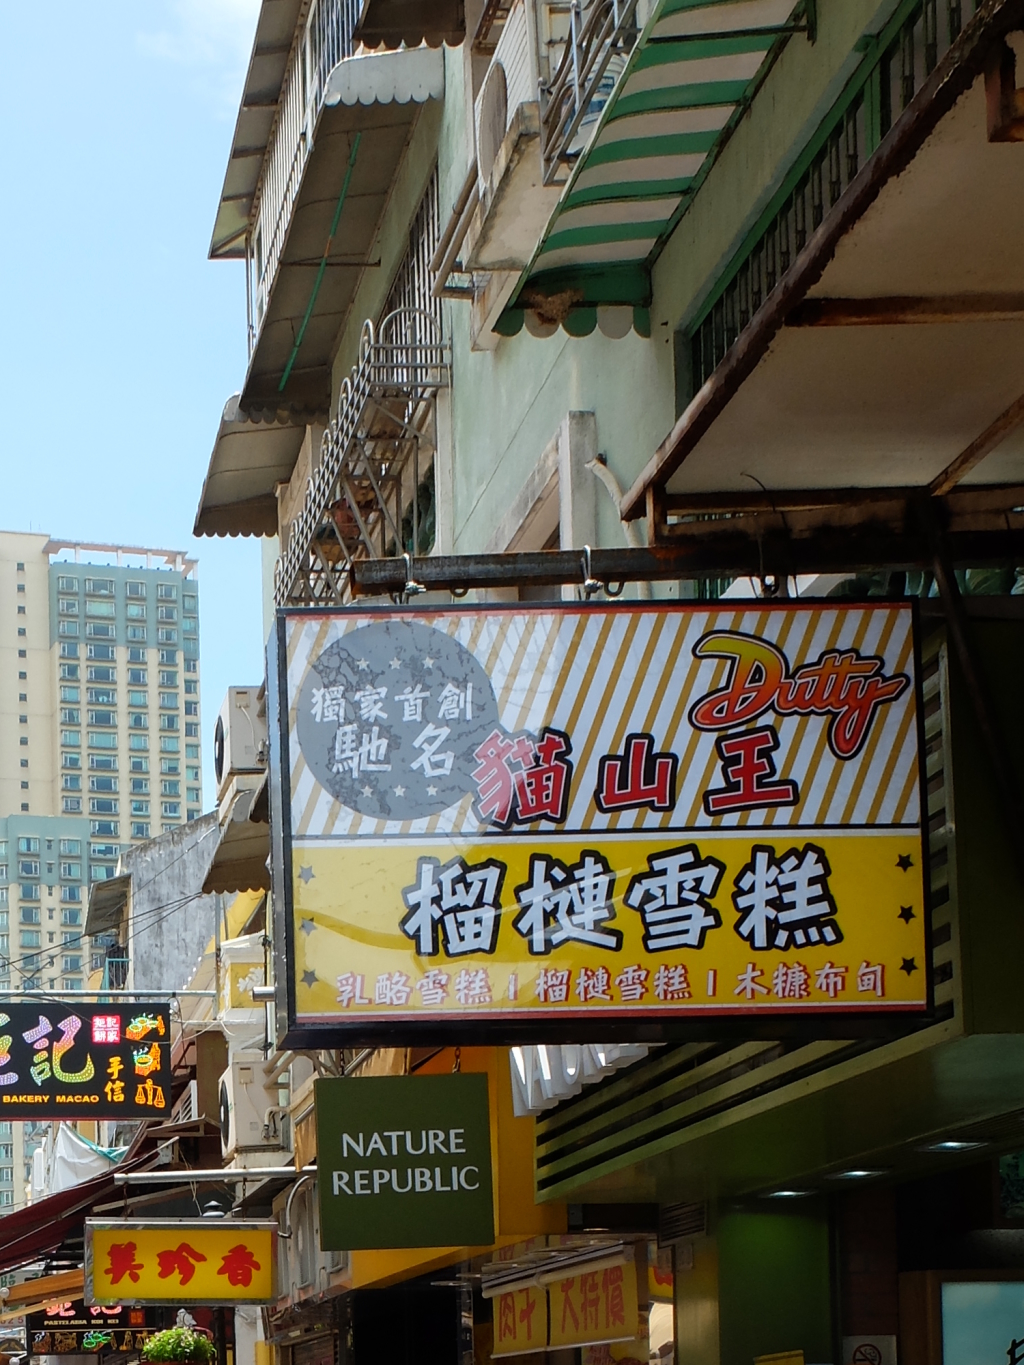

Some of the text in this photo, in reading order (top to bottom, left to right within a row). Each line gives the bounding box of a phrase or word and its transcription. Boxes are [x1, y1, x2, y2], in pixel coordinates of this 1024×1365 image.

[310, 682, 473, 723] 獨家首創
[688, 629, 911, 760] Dutty
[331, 722, 455, 779] 馳名
[473, 726, 799, 825] 貓山王
[401, 843, 843, 957] 榴槤雪糕
[336, 969, 491, 1008] 乳酪雪糕
[733, 961, 886, 999] 木糠布甸
[2, 1094, 50, 1104] BAKERY
[55, 1094, 100, 1104] MACAO
[104, 1056, 126, 1103] 手信
[340, 1128, 467, 1158] NATURE
[331, 1165, 480, 1196] REPUBLIC
[560, 1264, 626, 1334] 大特價
